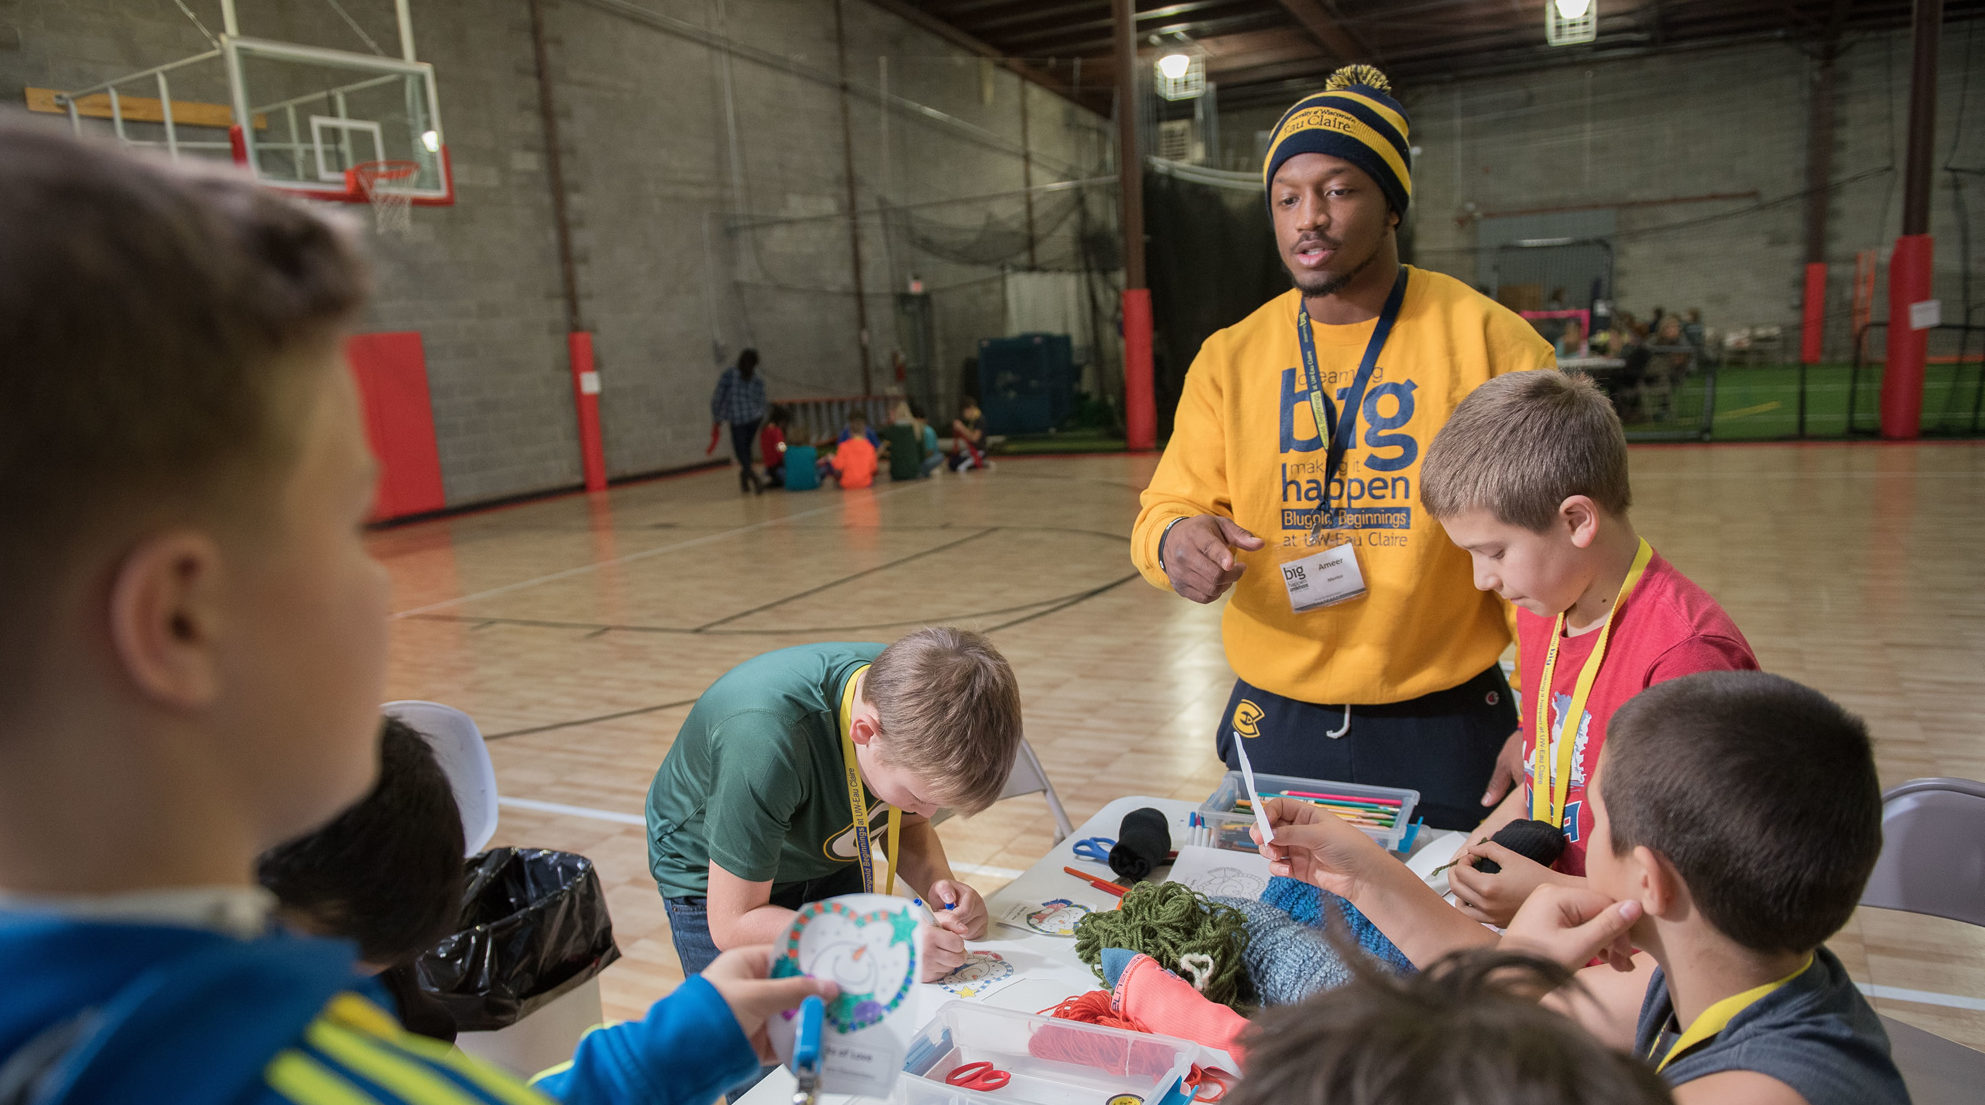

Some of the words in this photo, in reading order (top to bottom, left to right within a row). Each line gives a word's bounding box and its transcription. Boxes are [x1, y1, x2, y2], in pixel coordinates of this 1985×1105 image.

[1307, 115, 1352, 133] Claire
[1290, 459, 1348, 476] makg
[1282, 463, 1410, 508] happen
[1338, 509, 1407, 529] Beginnings
[1283, 533, 1297, 547] at
[1368, 531, 1408, 547] Claire
[1283, 565, 1306, 580] big
[1318, 558, 1344, 571] Ameer
[859, 827, 870, 867] Beginnings
